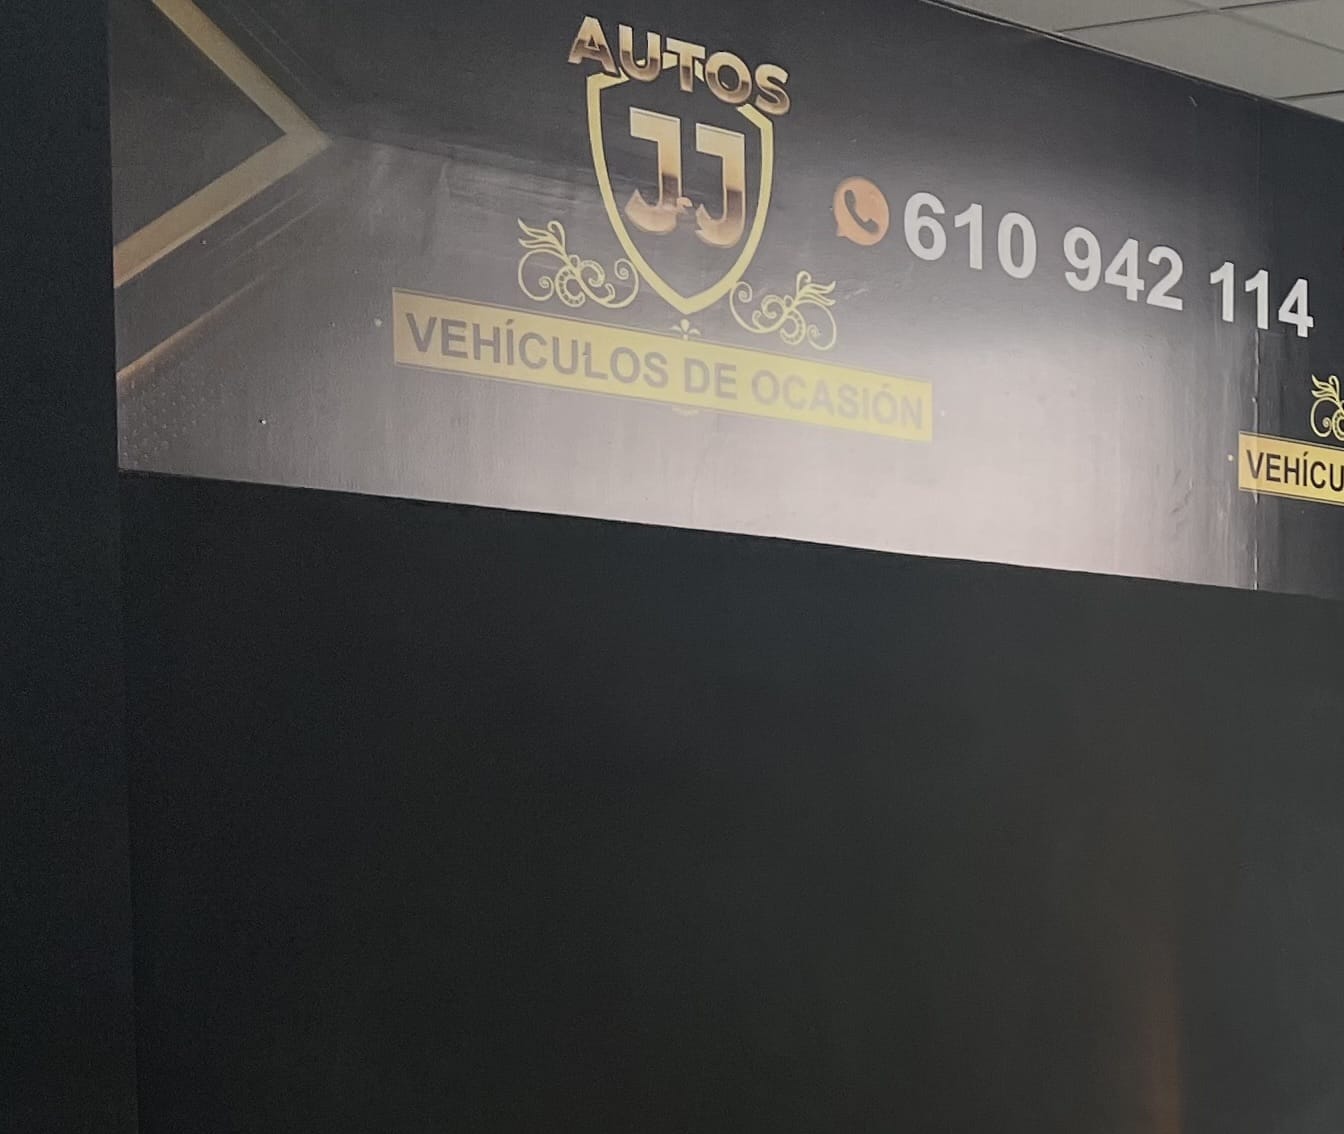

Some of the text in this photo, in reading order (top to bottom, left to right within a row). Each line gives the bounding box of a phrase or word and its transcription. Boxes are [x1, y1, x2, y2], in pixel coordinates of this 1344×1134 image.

[567, 15, 791, 115] AUTOS
[903, 192, 1314, 338] 610 942 114
[405, 312, 924, 430] VEHÍCULOS DE OCASIÓN
